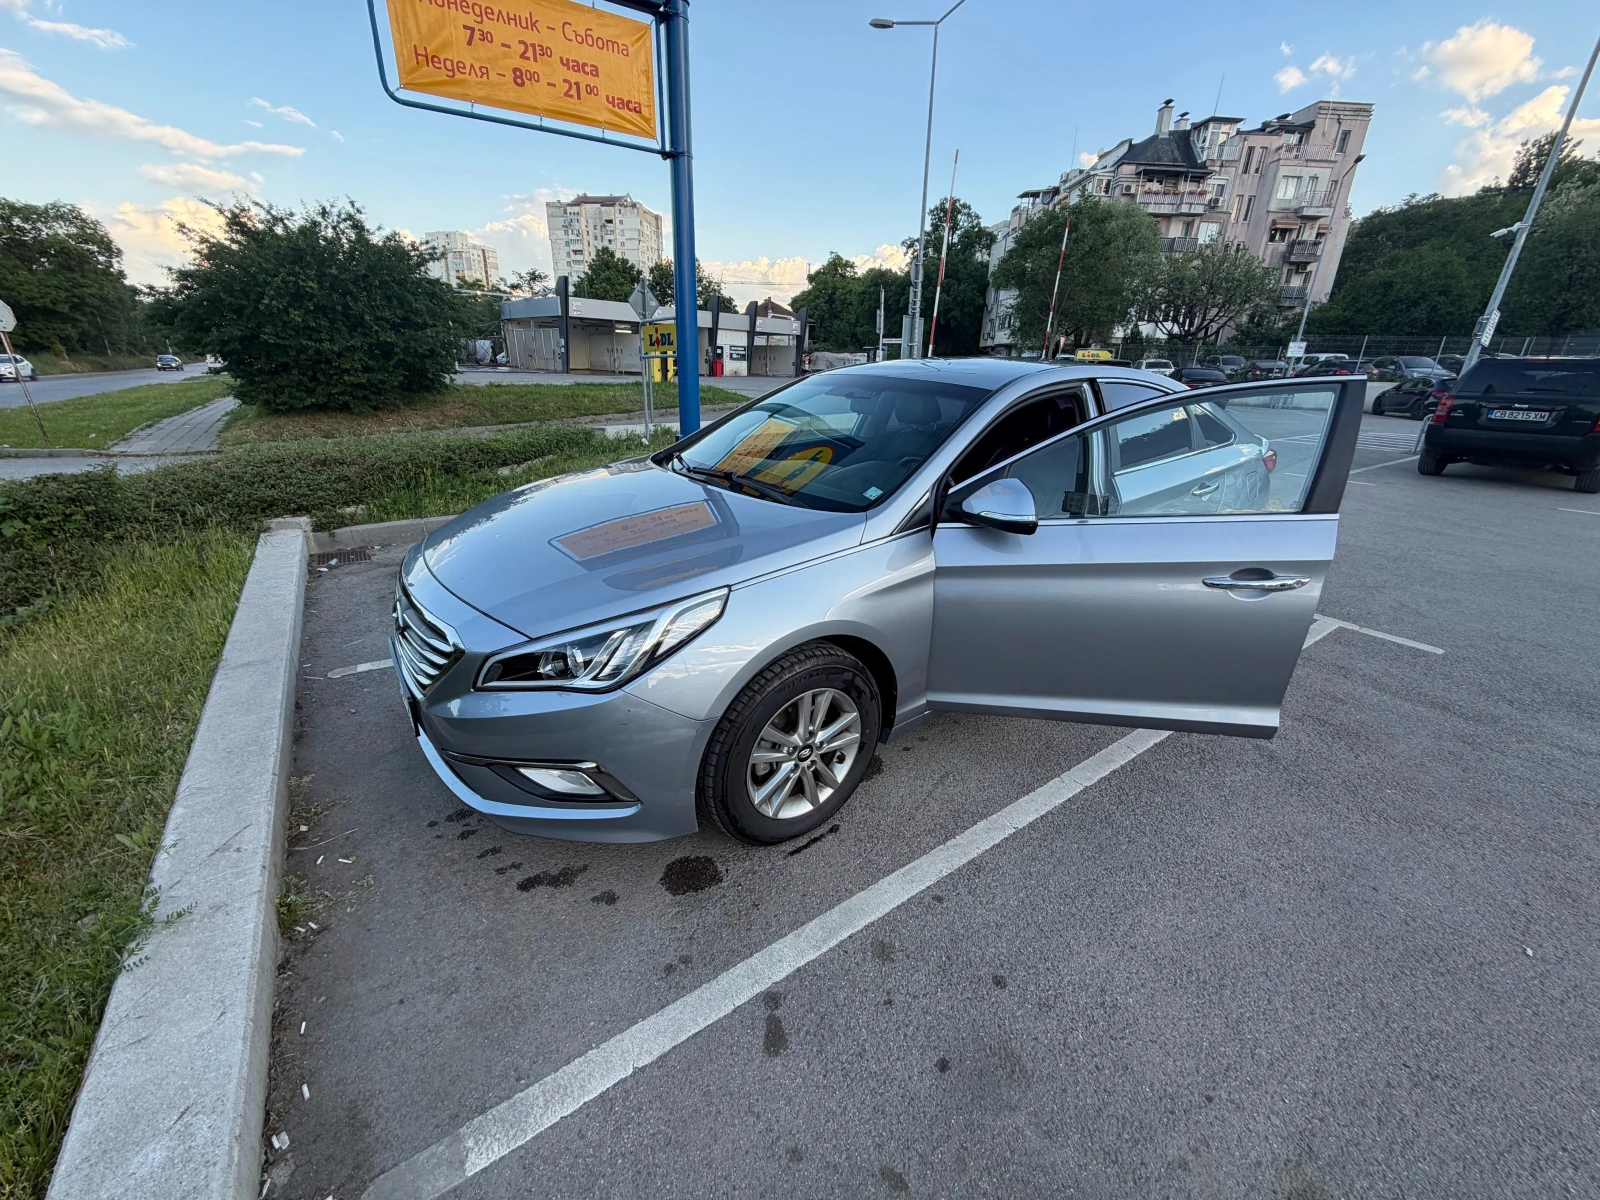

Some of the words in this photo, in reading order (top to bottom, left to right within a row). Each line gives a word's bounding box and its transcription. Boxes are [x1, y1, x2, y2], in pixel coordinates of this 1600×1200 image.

[419, 0, 541, 34] онеделник
[562, 21, 630, 57] Събота
[413, 44, 490, 80] Неделя
[605, 94, 643, 115] часа
[559, 56, 600, 78] часа
[1507, 411, 1532, 420] 8215
